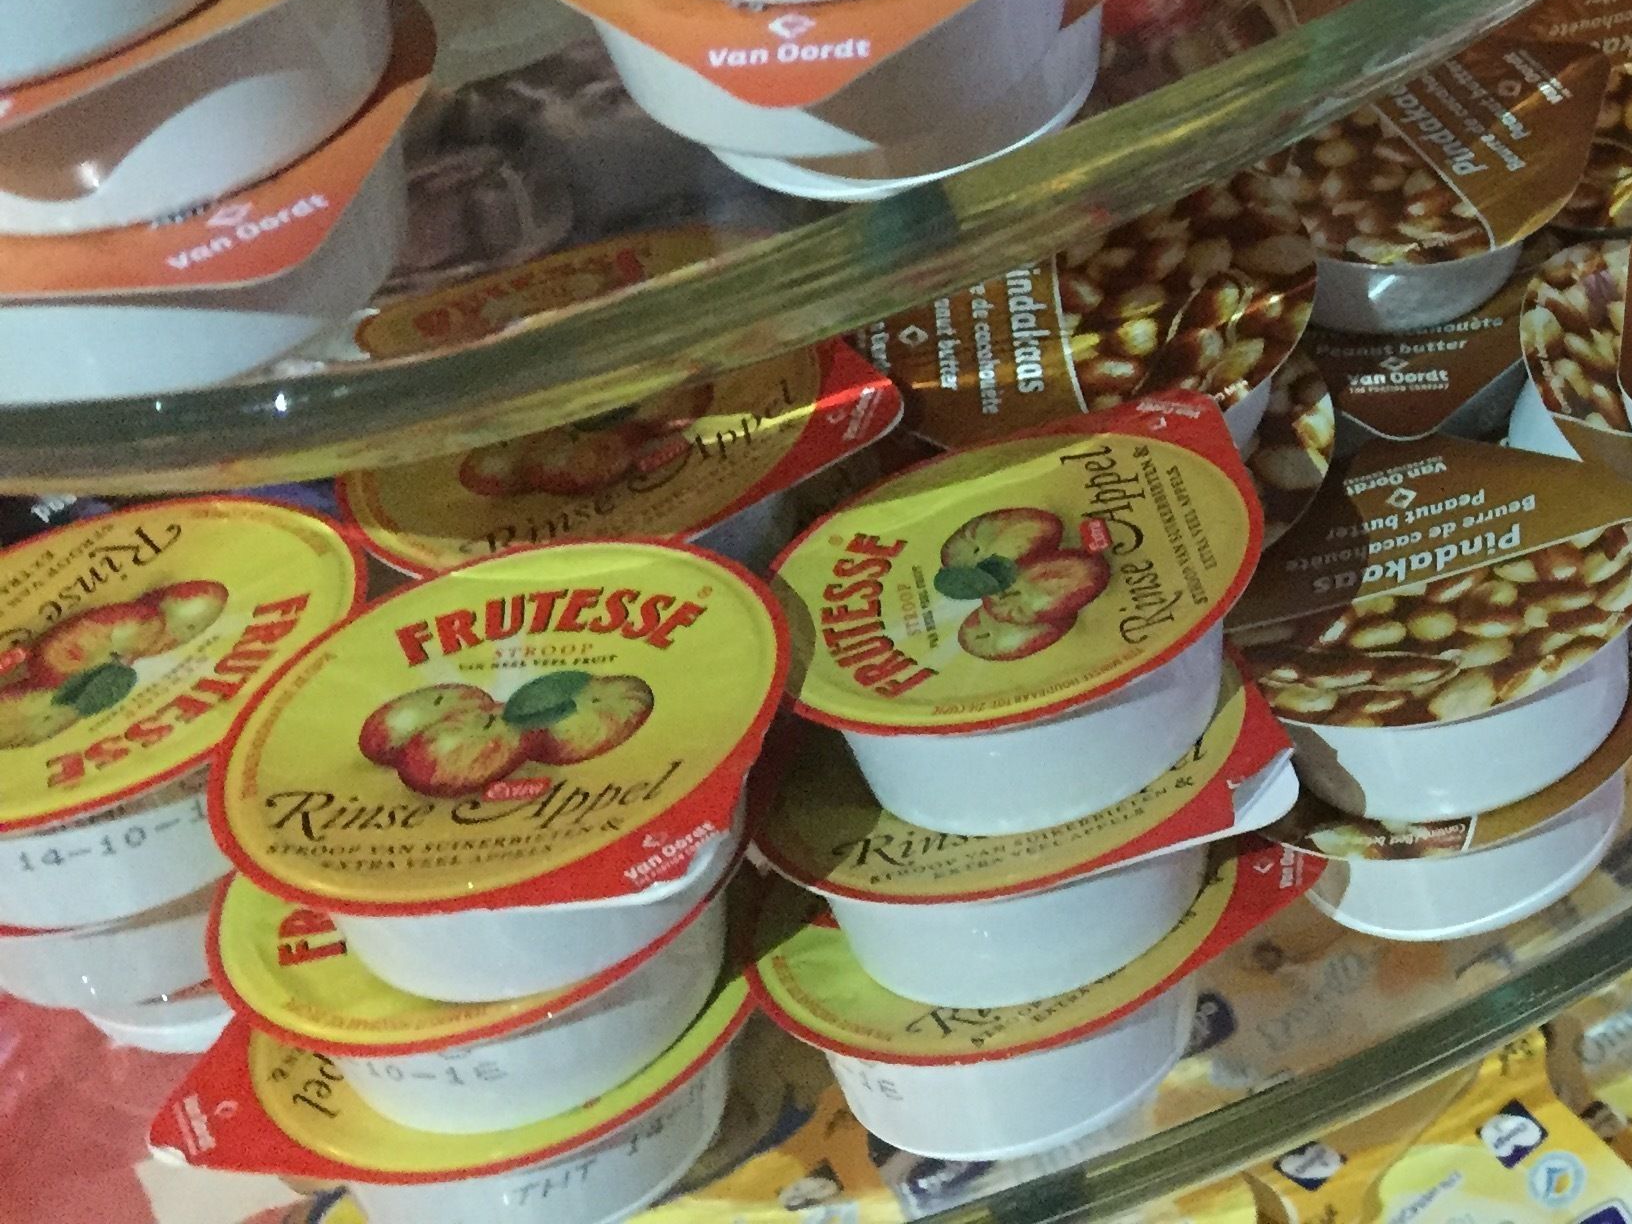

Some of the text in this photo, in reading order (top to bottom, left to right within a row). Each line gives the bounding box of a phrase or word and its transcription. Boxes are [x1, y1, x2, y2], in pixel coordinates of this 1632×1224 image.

[708, 38, 872, 69] Van Oordt
[1392, 84, 1490, 176] Pindaka
[165, 193, 330, 271] Van Oordt
[1350, 368, 1450, 387] Van Oordt
[1399, 338, 1469, 356] butter
[1324, 487, 1486, 542] Peanut butter
[1346, 462, 1448, 498] Van Oordt
[1461, 493, 1537, 529] Beurre
[1058, 444, 1186, 646] Rinse Appel
[1312, 522, 1522, 595] Pindakaas
[1427, 521, 1457, 540] de
[37, 523, 183, 622] Rinse
[394, 586, 709, 667] FRUTESSE
[819, 532, 940, 698] FRUTESSE
[46, 592, 312, 789] FRUTESSE
[264, 760, 685, 842] Rinse Appel
[623, 854, 663, 880] Van
